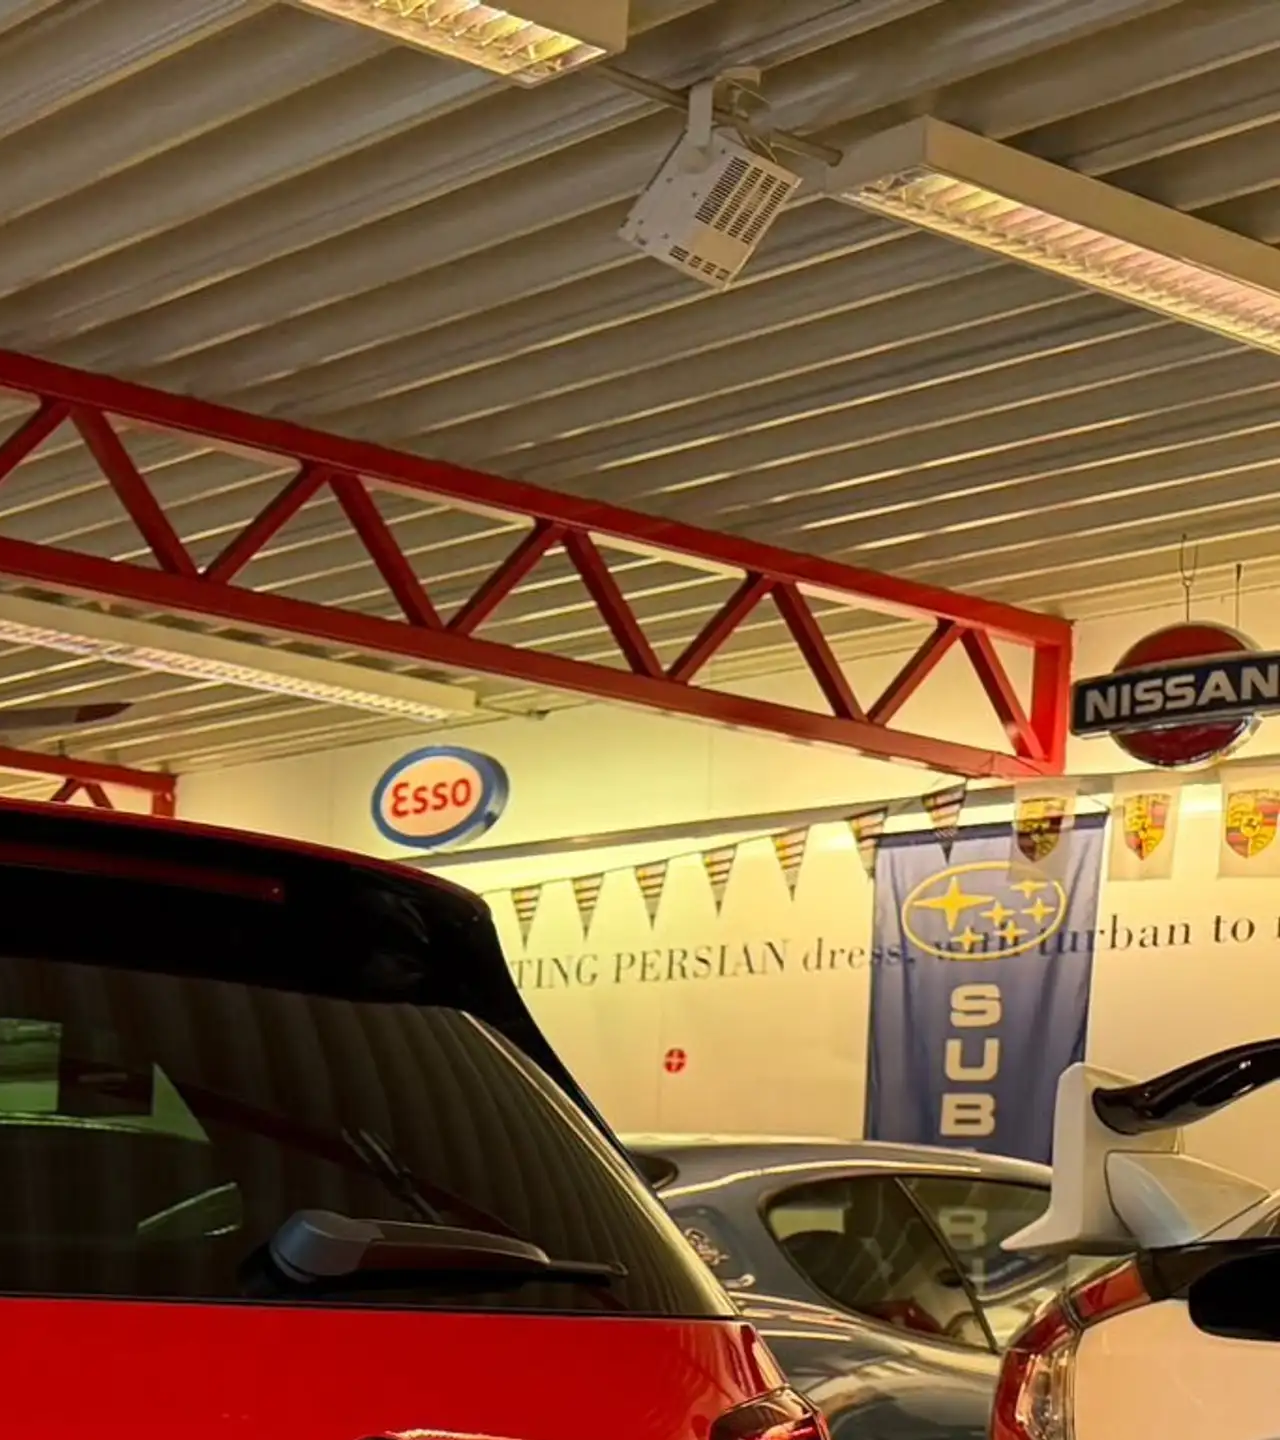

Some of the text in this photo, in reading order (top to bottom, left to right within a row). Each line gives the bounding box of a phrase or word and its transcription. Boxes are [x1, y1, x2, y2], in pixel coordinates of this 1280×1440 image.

[1084, 664, 1279, 723] NISSAN
[612, 939, 791, 984] PERSIAN
[1211, 914, 1255, 944] to
